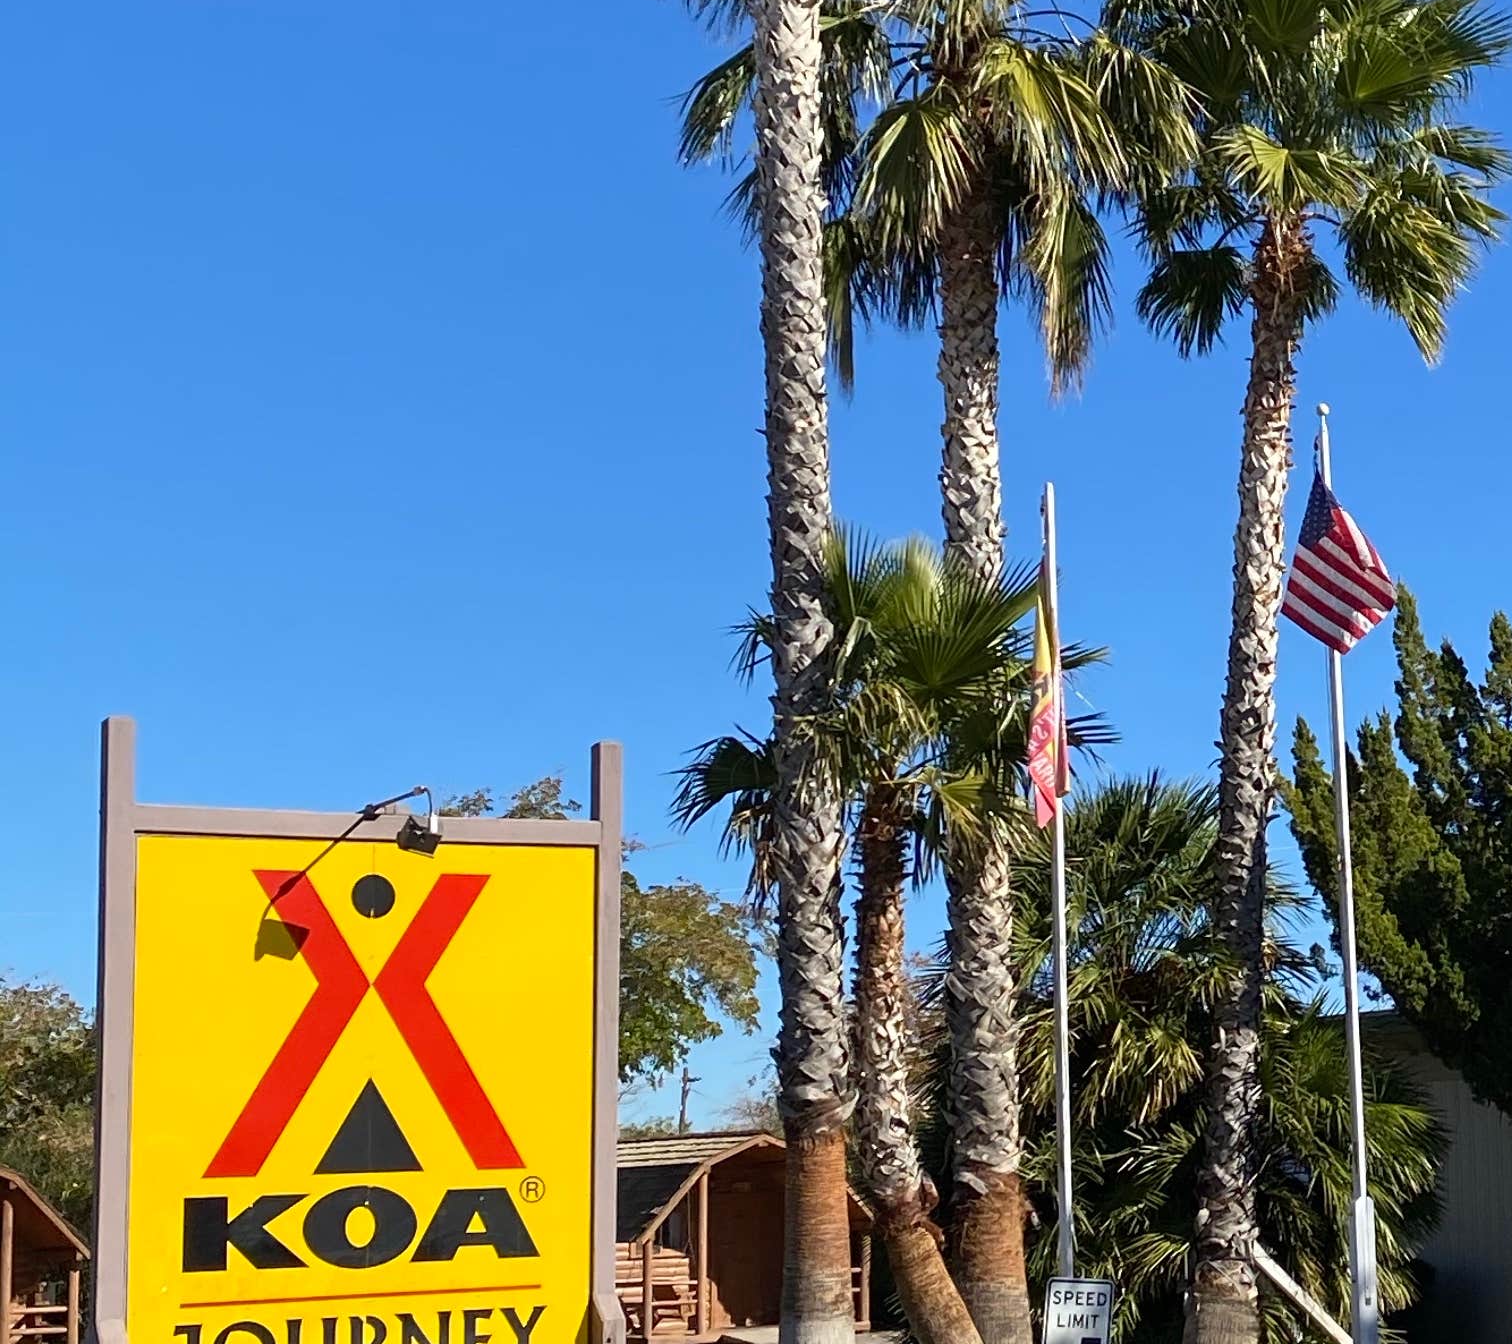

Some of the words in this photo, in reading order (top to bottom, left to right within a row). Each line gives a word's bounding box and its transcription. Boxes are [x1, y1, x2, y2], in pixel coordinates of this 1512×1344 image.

[182, 1185, 541, 1273] KOA
[1052, 1290, 1107, 1307] SPEED
[1057, 1312, 1100, 1329] LIMIT
